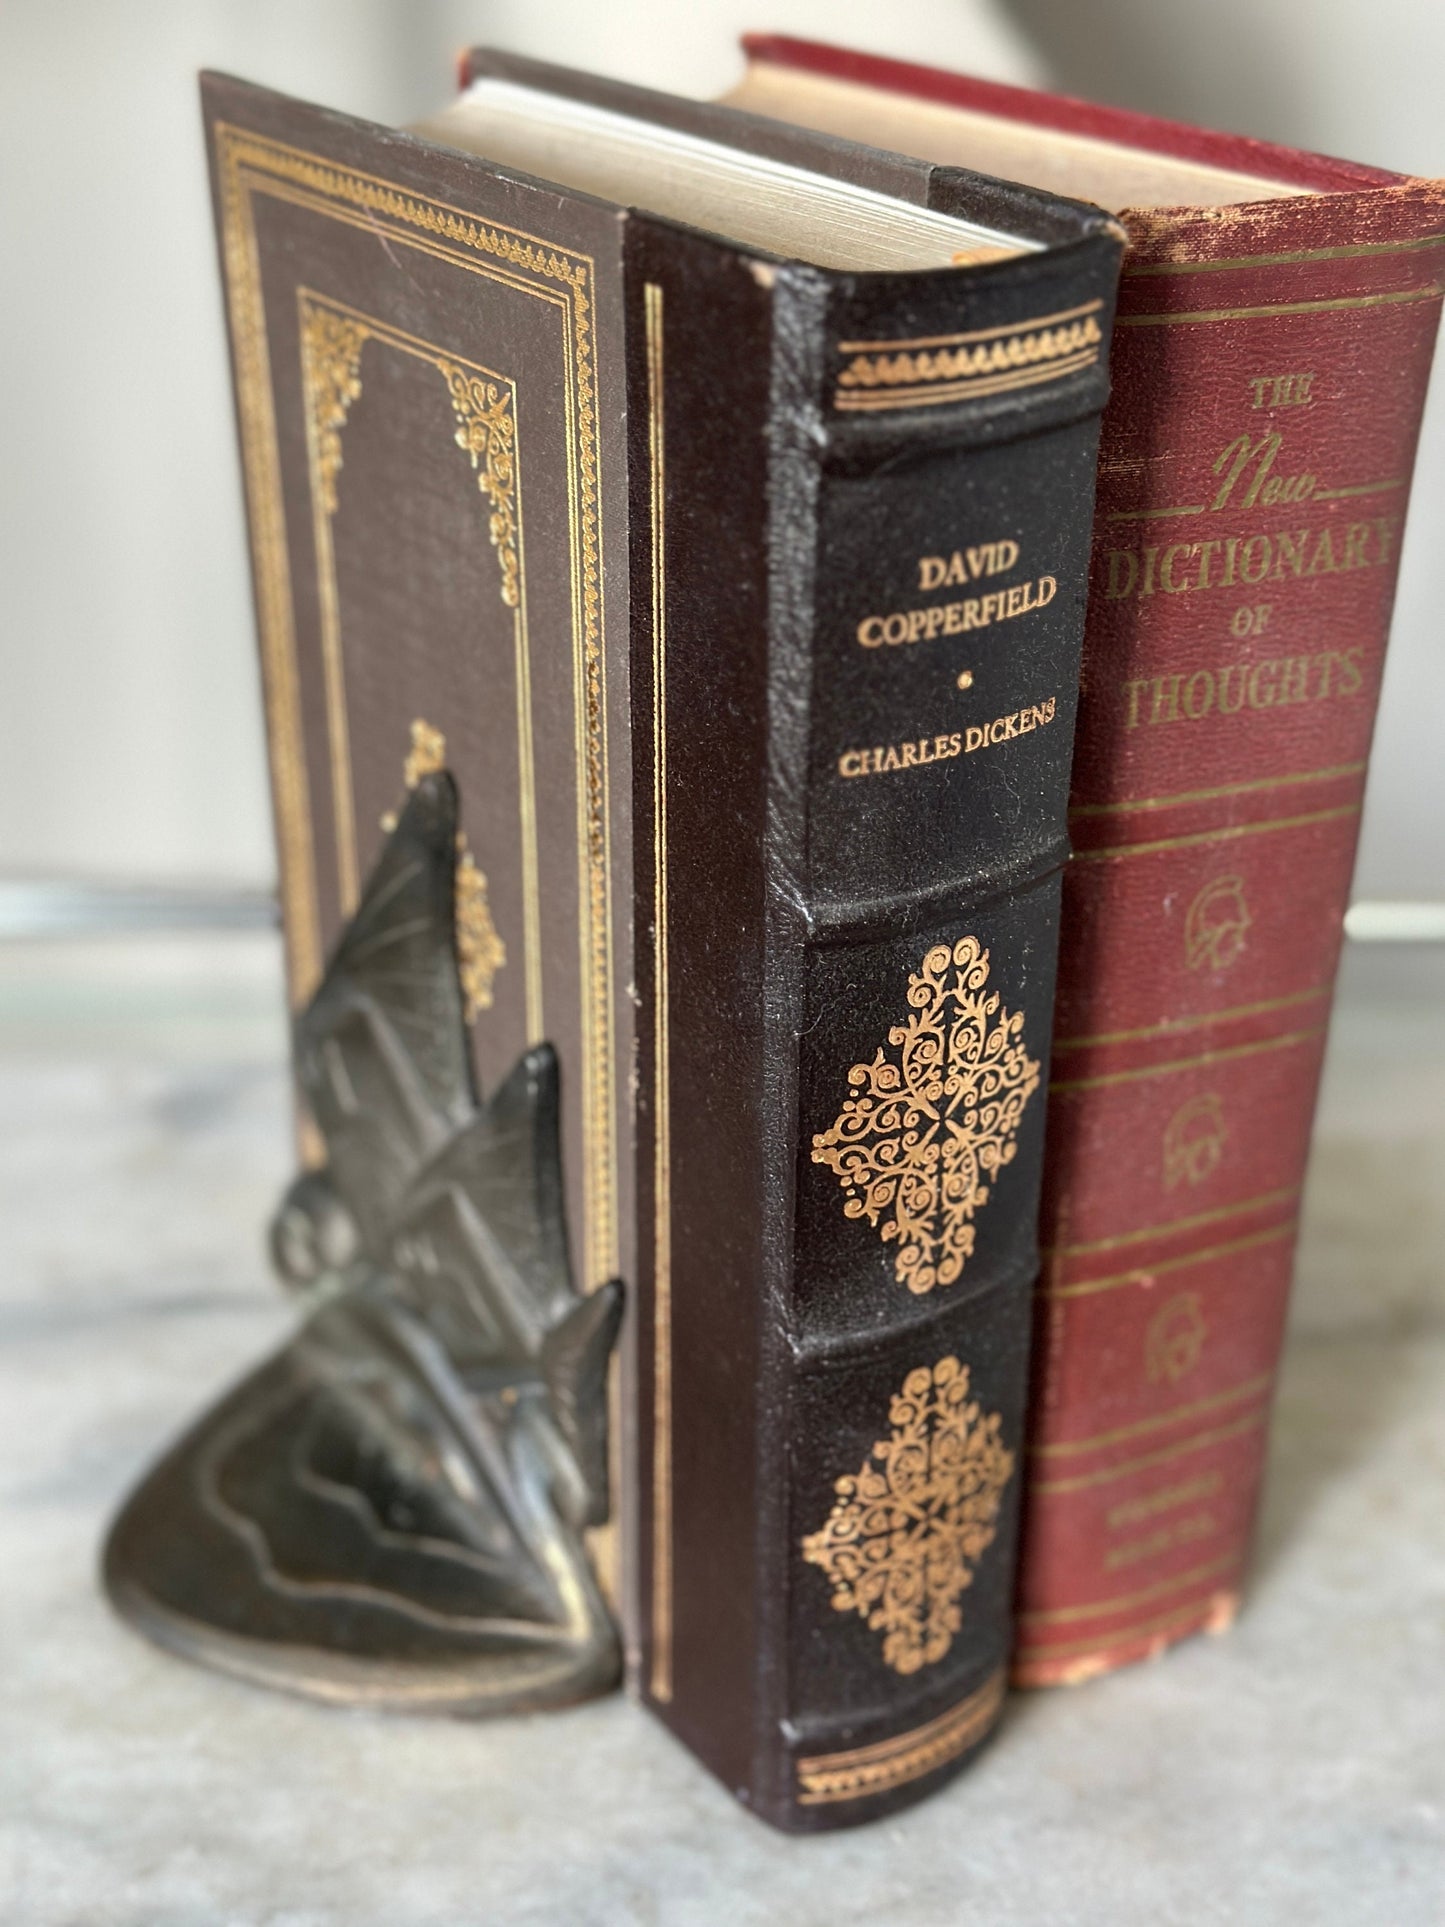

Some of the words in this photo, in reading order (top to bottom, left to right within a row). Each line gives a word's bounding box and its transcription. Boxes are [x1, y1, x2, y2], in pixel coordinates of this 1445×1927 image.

[1250, 373, 1314, 409] THE
[1212, 433, 1316, 512] New
[918, 539, 1019, 591] DAVID
[1105, 516, 1400, 600] DICTIONARY
[857, 576, 1057, 648] COPPERFIELD
[1230, 605, 1272, 637] OF
[1122, 647, 1364, 730] THOUGHTS
[838, 733, 961, 778] CHARLES
[965, 697, 1057, 753] DICKENS
